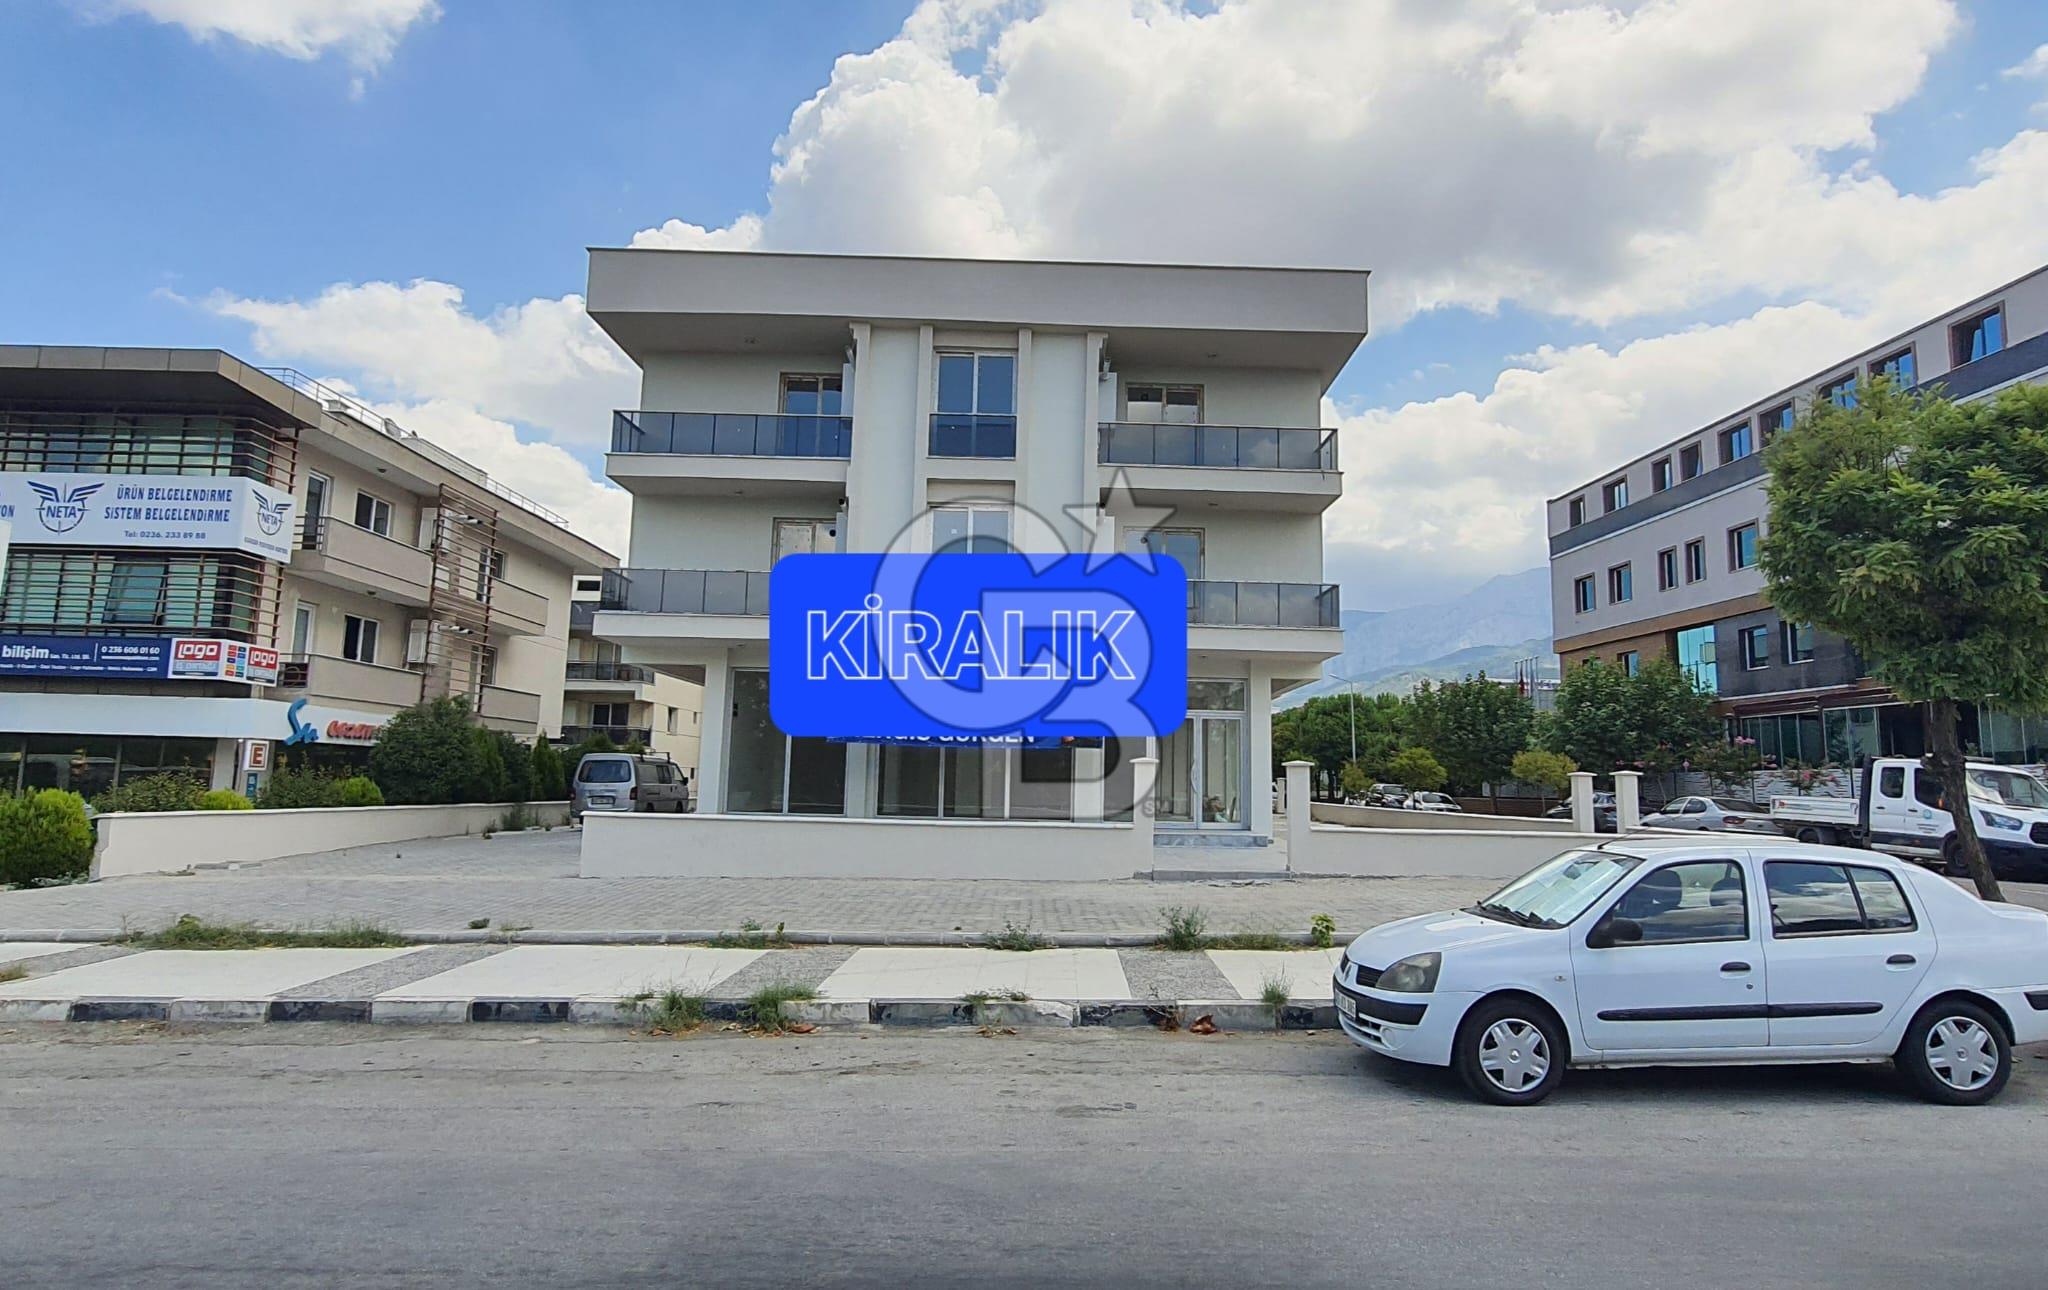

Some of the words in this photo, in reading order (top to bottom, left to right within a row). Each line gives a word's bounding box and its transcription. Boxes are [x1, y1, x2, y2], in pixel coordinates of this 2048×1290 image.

[117, 484, 145, 500] ÜRÜN
[0, 504, 15, 518] ON
[46, 505, 77, 519] NETA
[2, 644, 49, 660] bilişim
